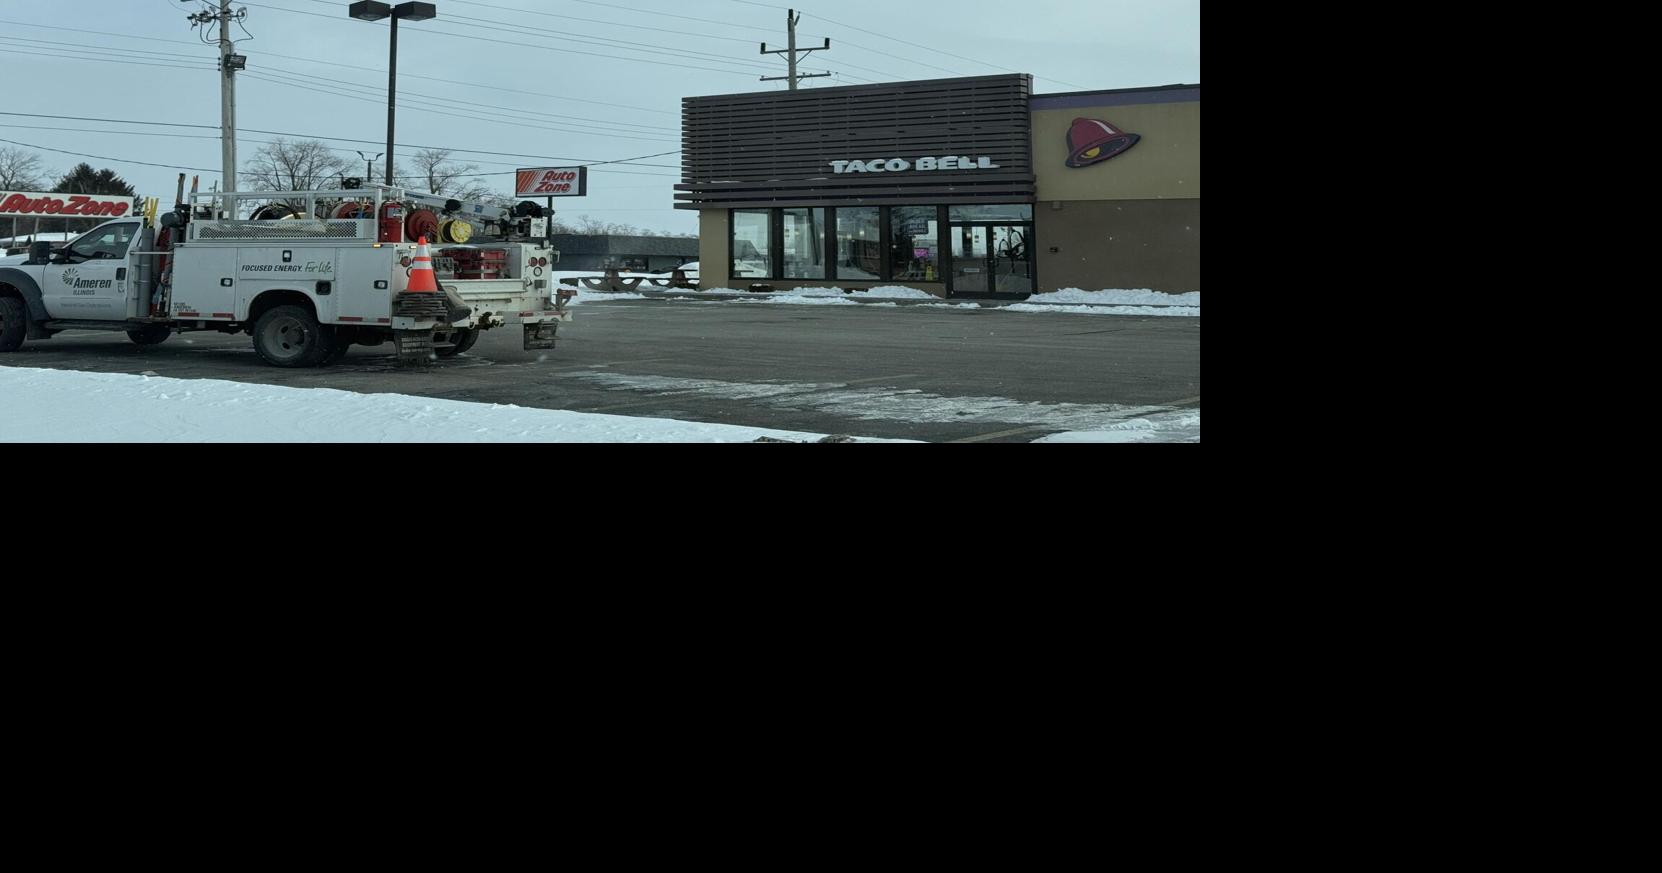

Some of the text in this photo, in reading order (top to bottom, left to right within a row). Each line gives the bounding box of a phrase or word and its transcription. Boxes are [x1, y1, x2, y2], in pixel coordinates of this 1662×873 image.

[829, 155, 1000, 174] TACO BELL
[541, 170, 576, 181] Auto
[534, 181, 571, 193] Zone
[0, 193, 129, 216] AutoZone
[241, 264, 273, 272] FOCUSED
[304, 261, 318, 273] For
[73, 277, 112, 289] Ameren
